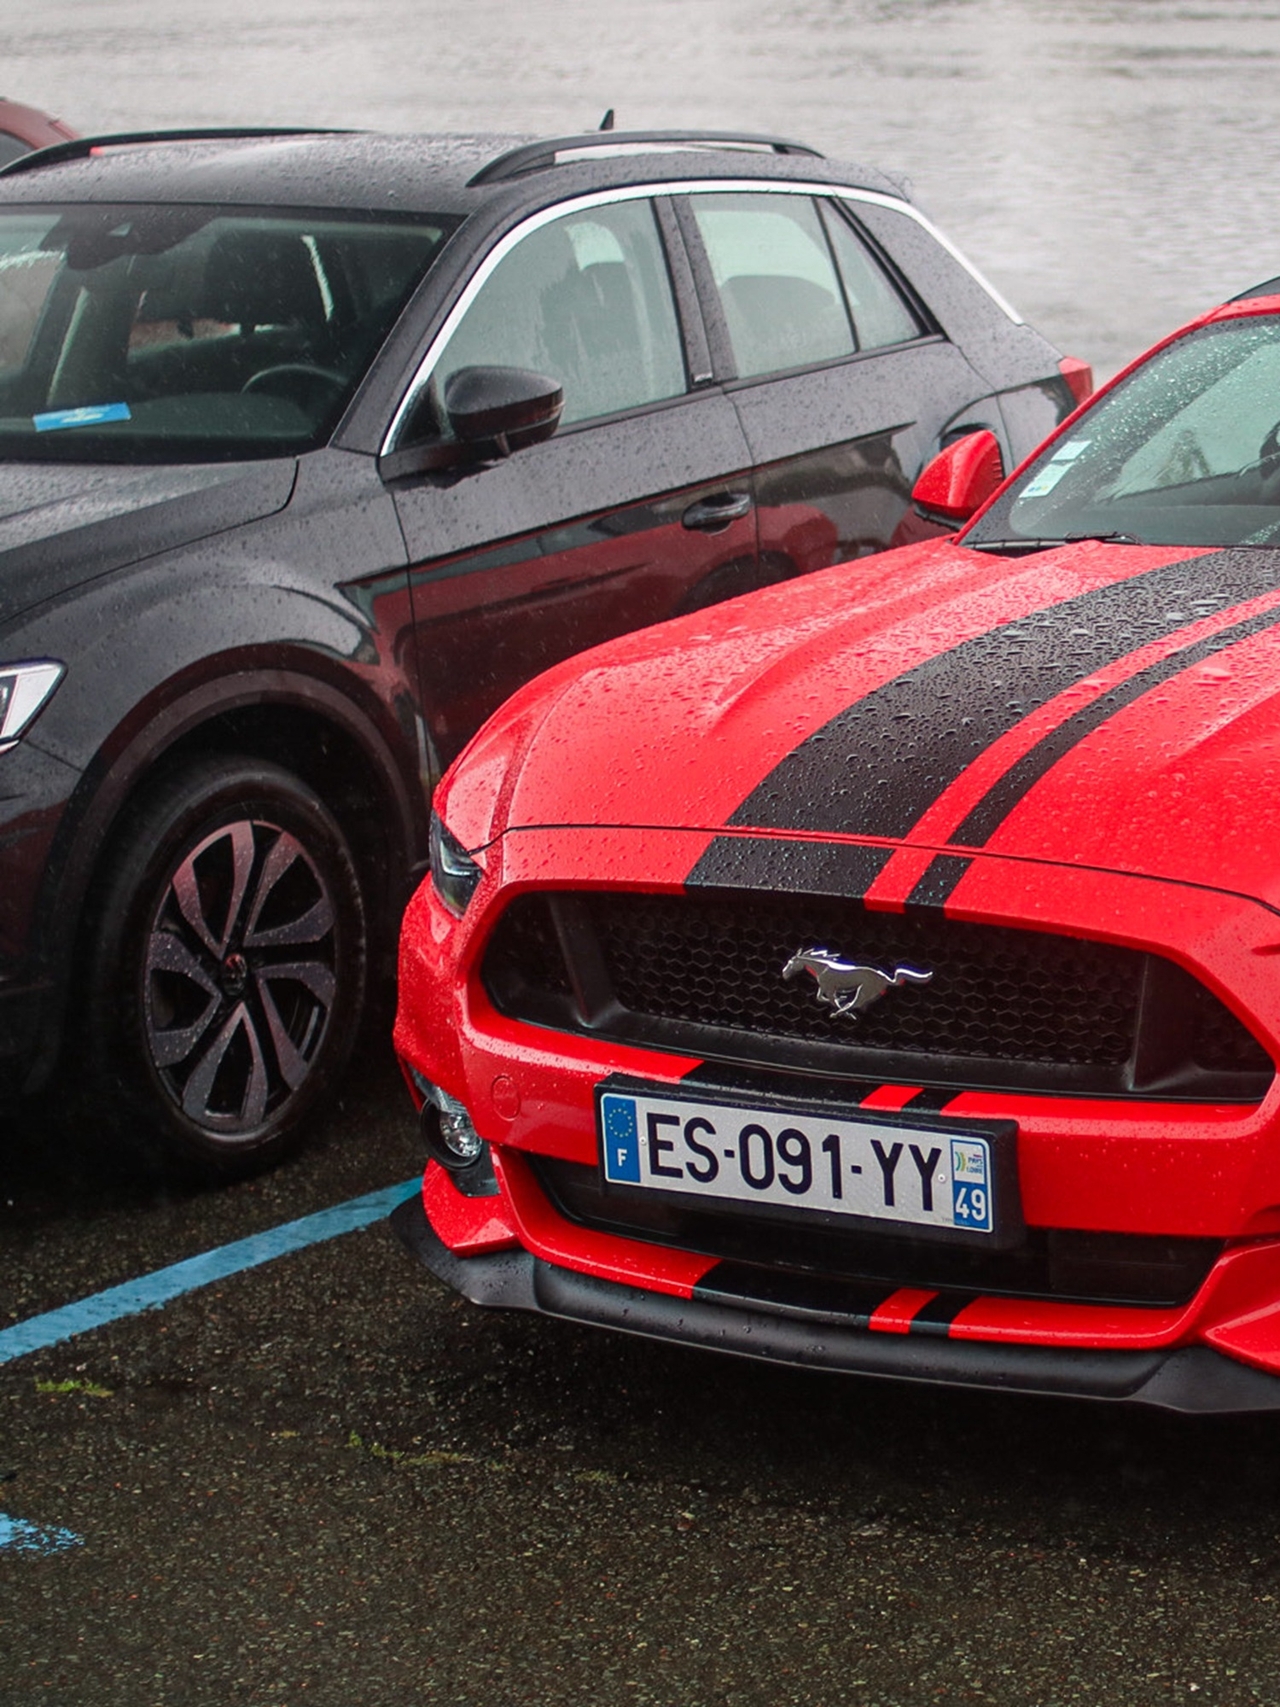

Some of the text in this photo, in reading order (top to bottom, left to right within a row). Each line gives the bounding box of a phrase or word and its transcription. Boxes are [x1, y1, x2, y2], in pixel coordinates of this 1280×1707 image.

[617, 1148, 628, 1167] F
[646, 1112, 941, 1212] ES-091-YY
[955, 1187, 986, 1221] 49
